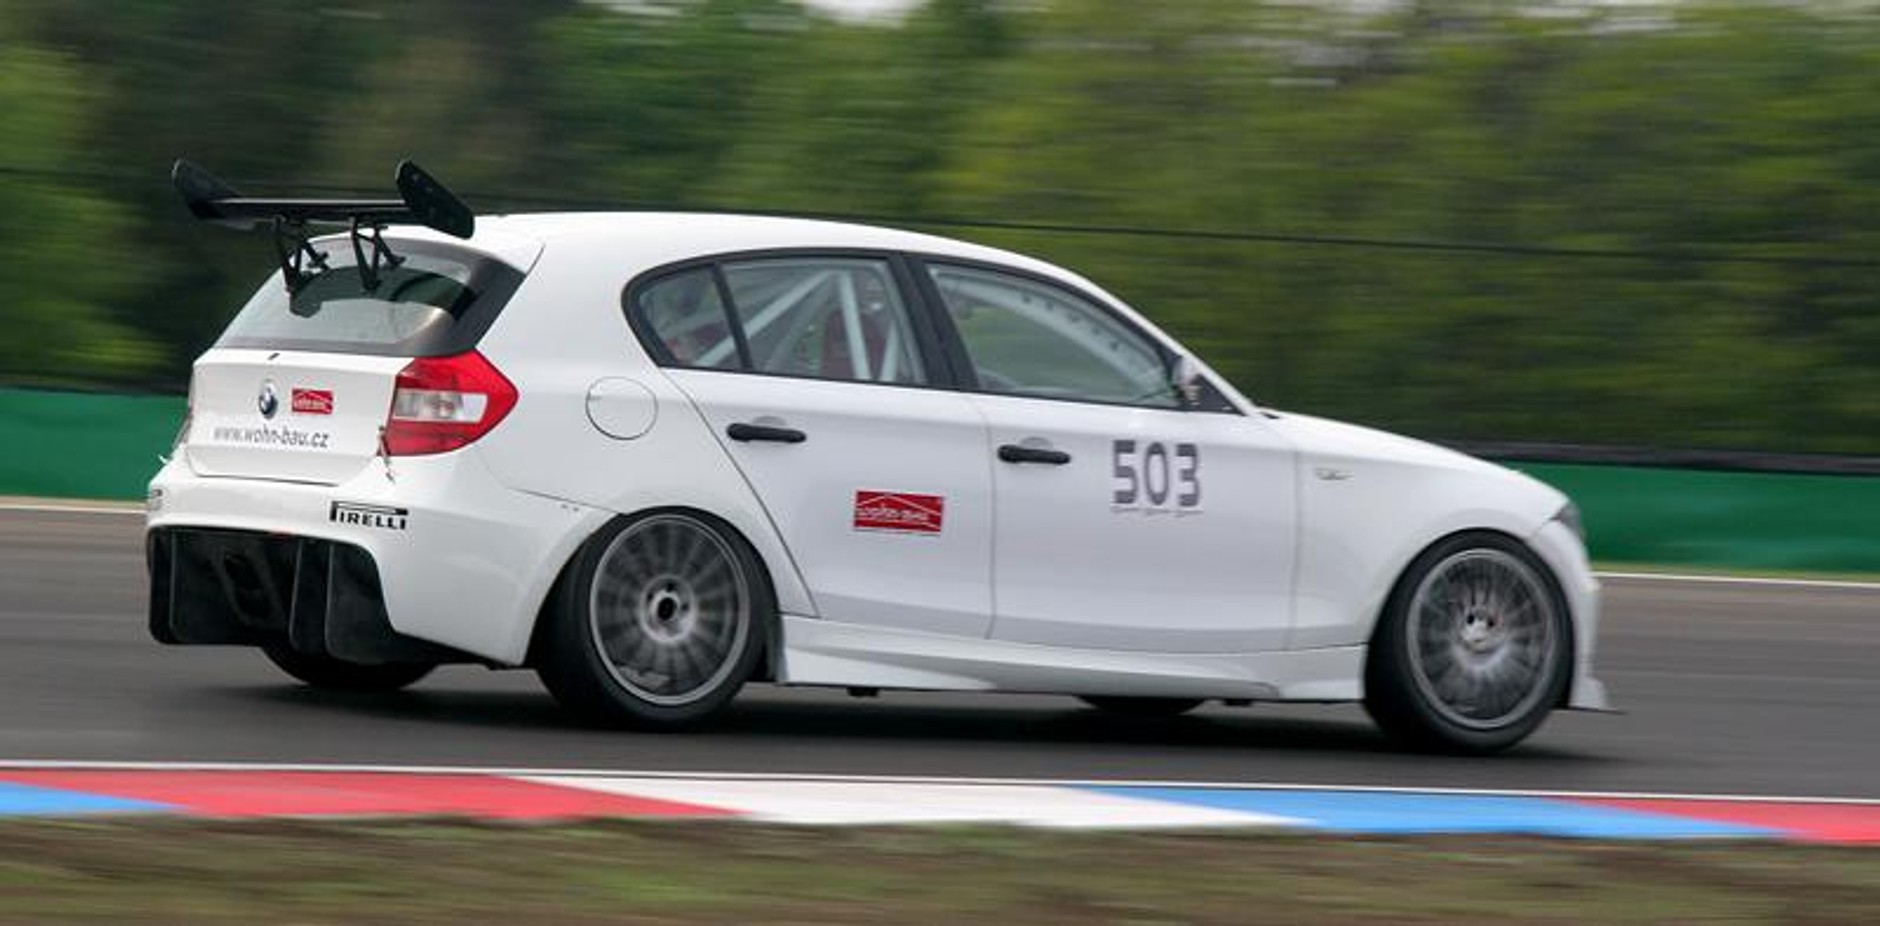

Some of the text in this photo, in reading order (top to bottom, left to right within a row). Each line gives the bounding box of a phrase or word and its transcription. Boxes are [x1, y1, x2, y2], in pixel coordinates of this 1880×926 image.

[214, 423, 329, 448] www.wohn-bau.cz
[1113, 439, 1200, 507] 503
[329, 500, 408, 530] PIRELLI
